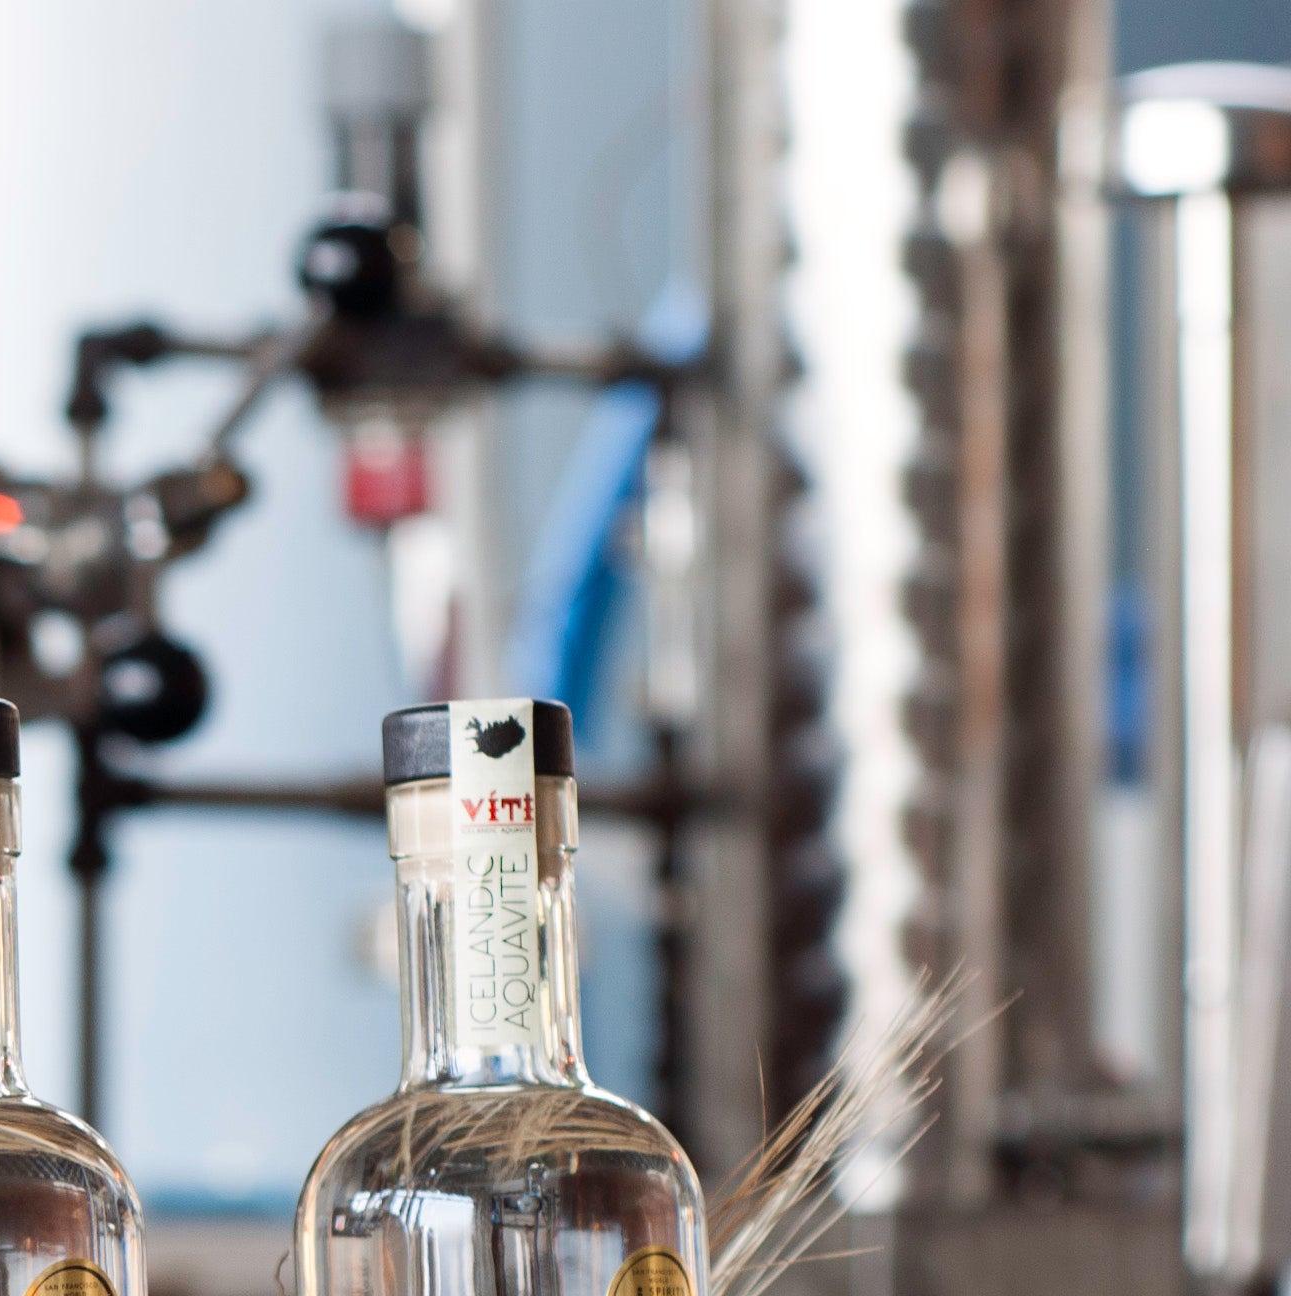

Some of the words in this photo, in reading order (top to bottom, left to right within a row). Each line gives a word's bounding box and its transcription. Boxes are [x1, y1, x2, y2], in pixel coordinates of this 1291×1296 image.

[467, 855, 498, 1030] ICELANDIC
[500, 853, 536, 1030] AQUAVITE
[649, 1286, 685, 1296] SPIRITS
